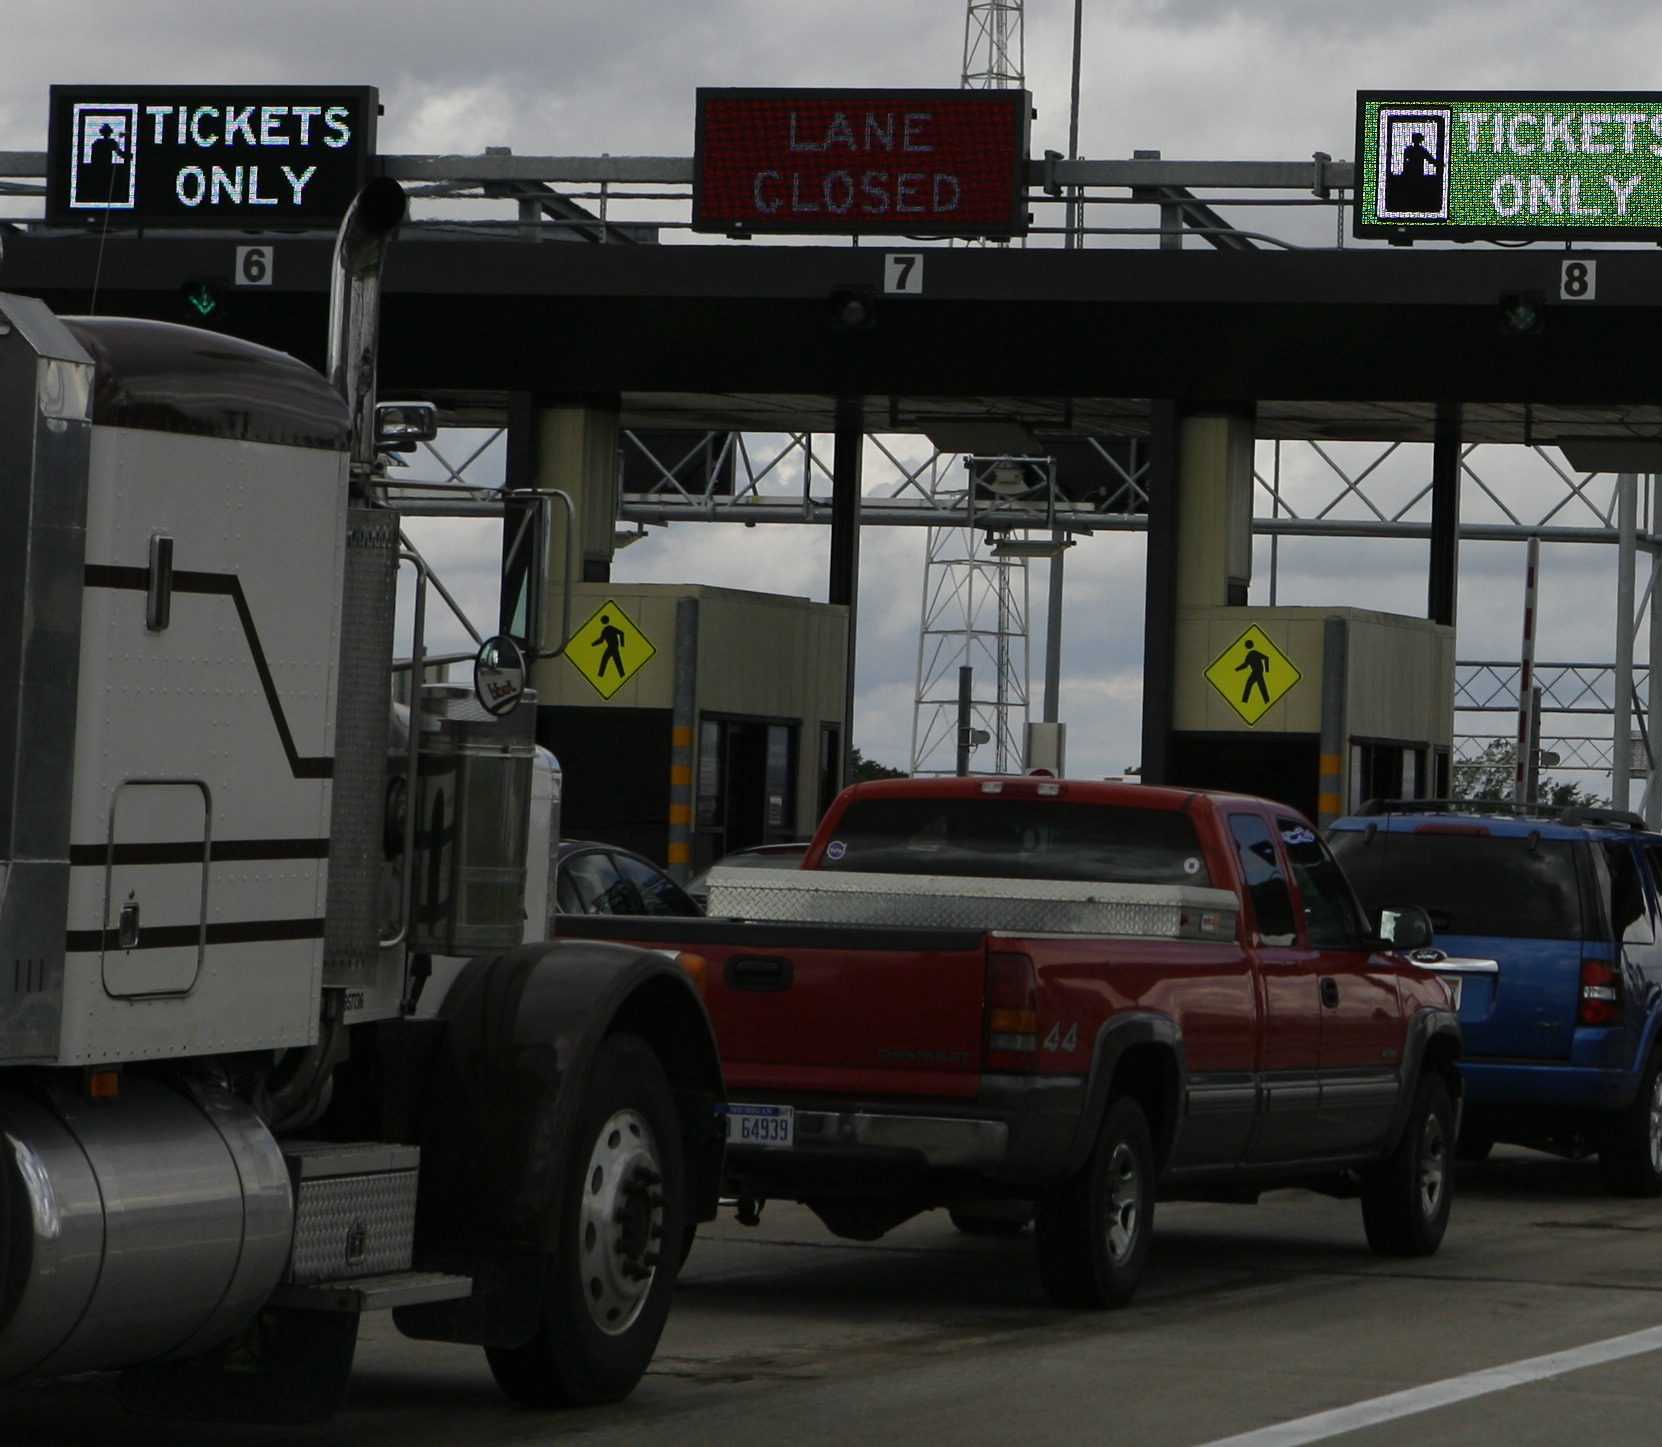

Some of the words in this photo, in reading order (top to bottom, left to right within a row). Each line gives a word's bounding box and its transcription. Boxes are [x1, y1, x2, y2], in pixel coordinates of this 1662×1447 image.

[146, 106, 351, 148] TICKETS
[790, 112, 934, 151] LANE
[176, 165, 317, 206] ONLY
[753, 170, 962, 214] CLOSED
[1492, 174, 1641, 216] ONLY
[242, 248, 266, 283] 6
[893, 257, 916, 290] 7
[1563, 262, 1588, 297] 8
[876, 1049, 972, 1062] CHEVROLET
[730, 1106, 772, 1114] MICHIGAN
[742, 1117, 788, 1140] 64939
